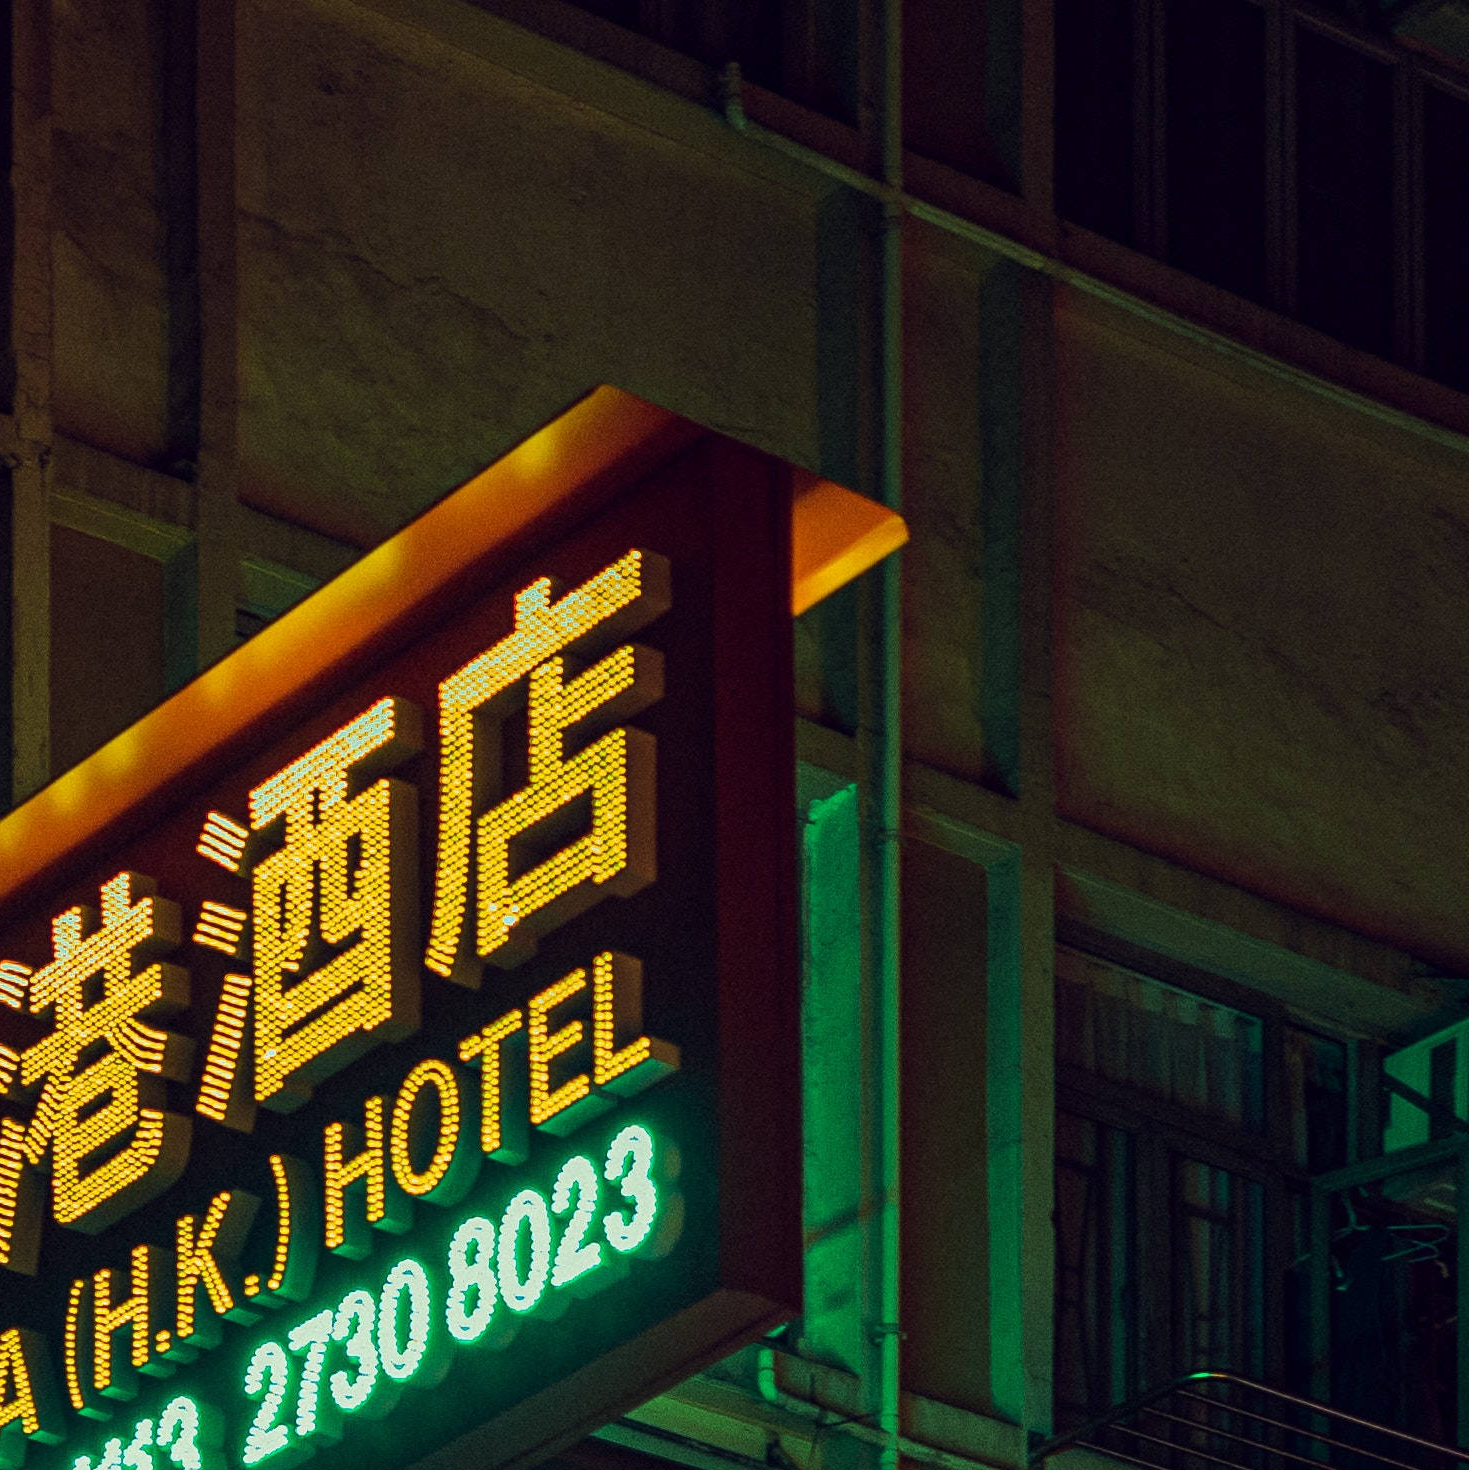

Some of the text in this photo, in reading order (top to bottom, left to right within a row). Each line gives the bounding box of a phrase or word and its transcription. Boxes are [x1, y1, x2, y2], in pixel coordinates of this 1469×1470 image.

[65, 1154, 292, 1411] (H.K.)
[323, 951, 652, 1251] HOTEL
[241, 1258, 430, 1468] 2730
[446, 1124, 658, 1343] 8023
